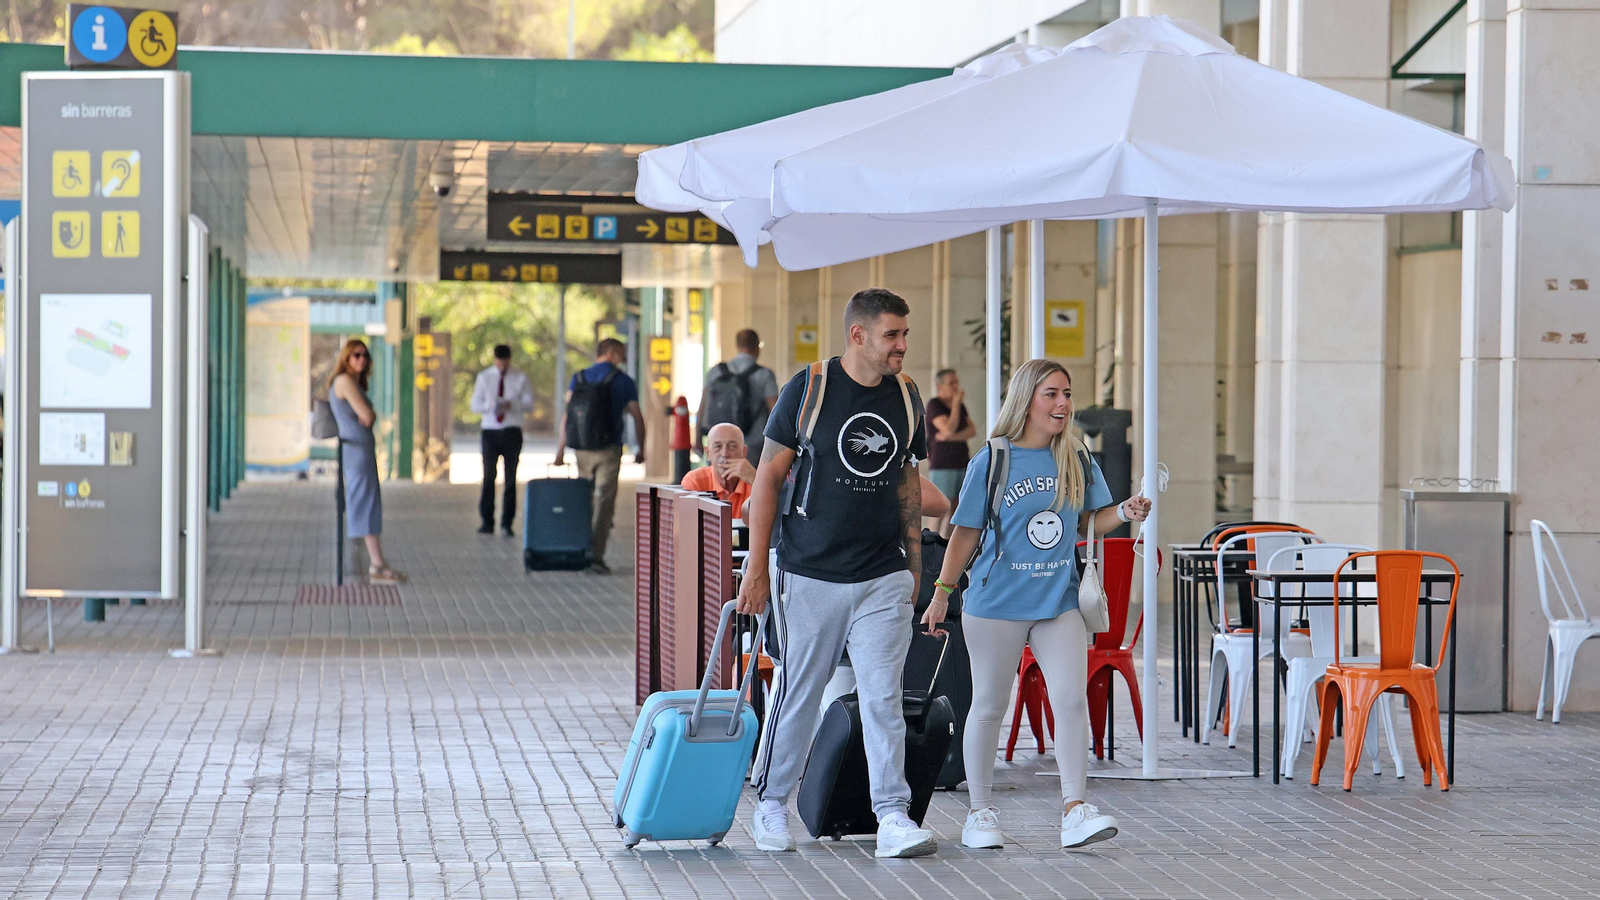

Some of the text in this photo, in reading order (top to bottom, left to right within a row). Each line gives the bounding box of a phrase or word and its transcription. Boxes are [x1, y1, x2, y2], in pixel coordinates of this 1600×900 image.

[61, 102, 132, 117] sin barreras
[598, 217, 613, 238] P
[835, 477, 858, 485] HOT
[1003, 478, 1035, 508] HIGH
[1010, 562, 1033, 570] JUST
[1034, 562, 1046, 570] BE
